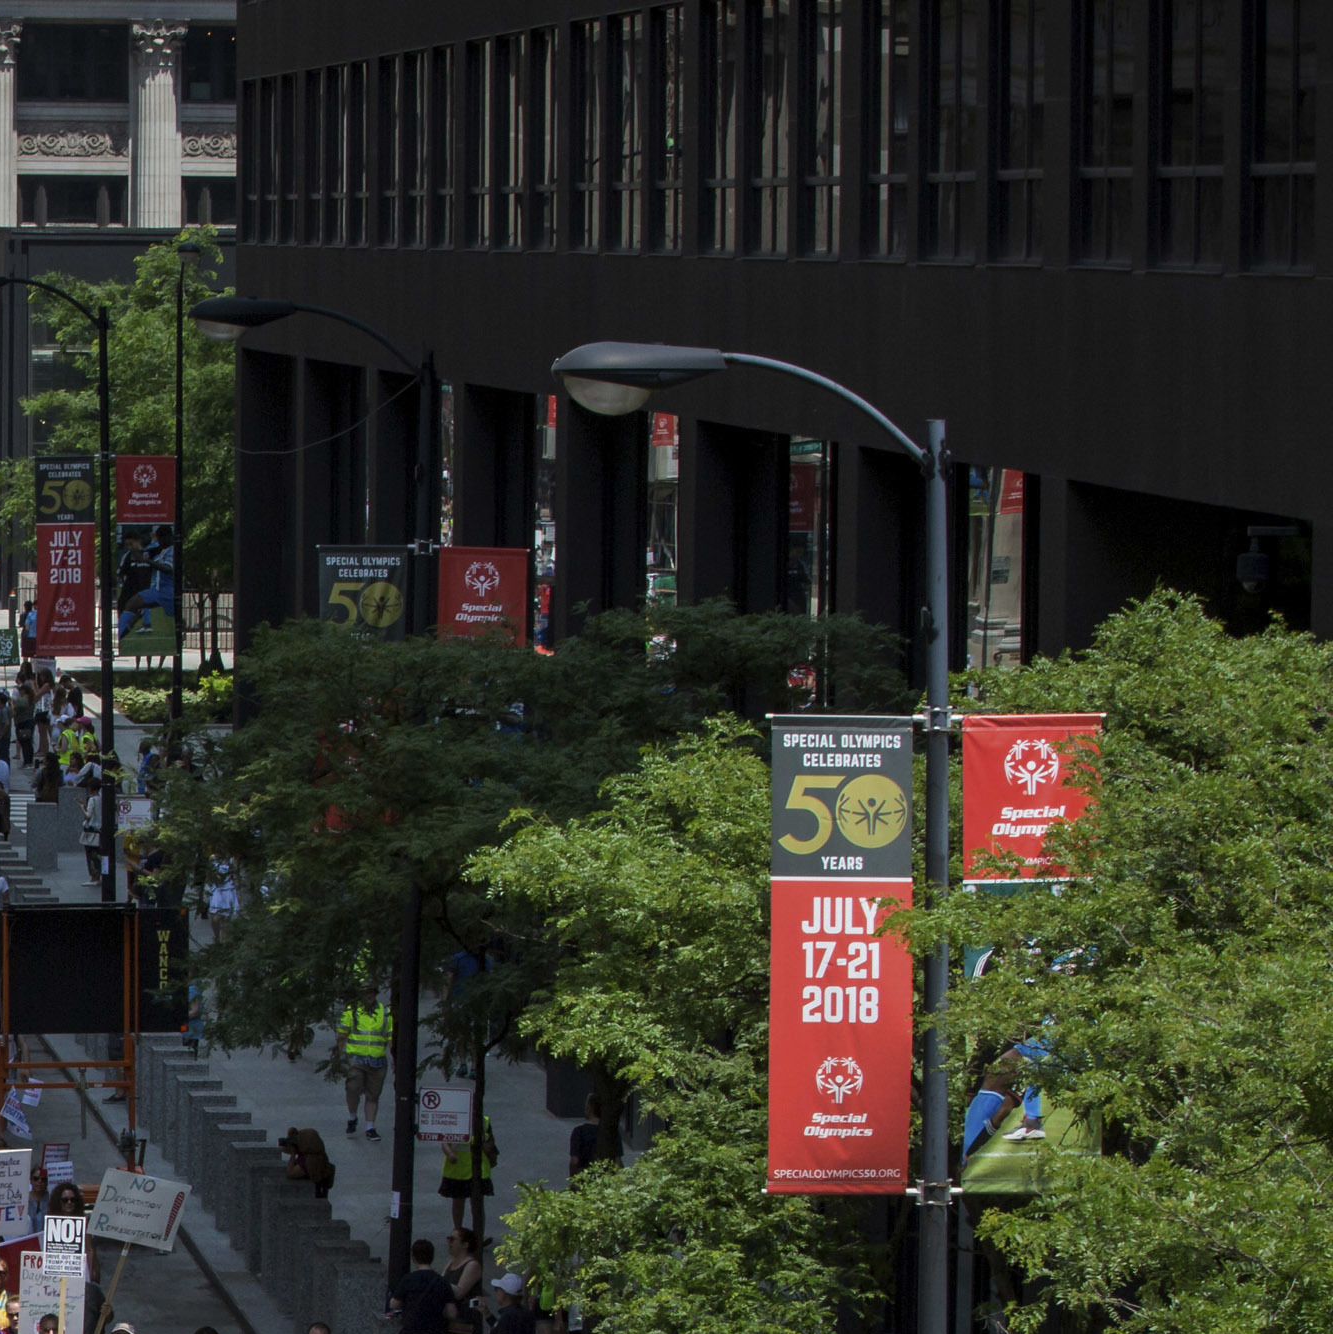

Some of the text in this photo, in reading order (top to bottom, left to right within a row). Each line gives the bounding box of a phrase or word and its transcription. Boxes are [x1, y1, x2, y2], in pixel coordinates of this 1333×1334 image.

[49, 531, 82, 547] JULY
[50, 550, 82, 565] 17-21
[326, 557, 400, 566] SPECIAL OLYMPICS
[50, 568, 82, 584] 2018
[339, 569, 388, 577] CELEBRATES
[461, 603, 502, 612] Special
[784, 734, 901, 749] SPECIAL OLYMPICS
[803, 753, 881, 768] CELEBRATES
[1001, 806, 1066, 820] Special
[821, 856, 864, 871] YEARS
[801, 897, 880, 934] JULY
[802, 942, 880, 979] 17-21
[802, 986, 879, 1023] 2018
[811, 1112, 867, 1124] Special
[804, 1125, 873, 1139] Olympics
[774, 1169, 901, 1179] SPECIALOLYMPICS50.ORG
[130, 1177, 156, 1193] NO
[47, 1219, 82, 1244] NO!
